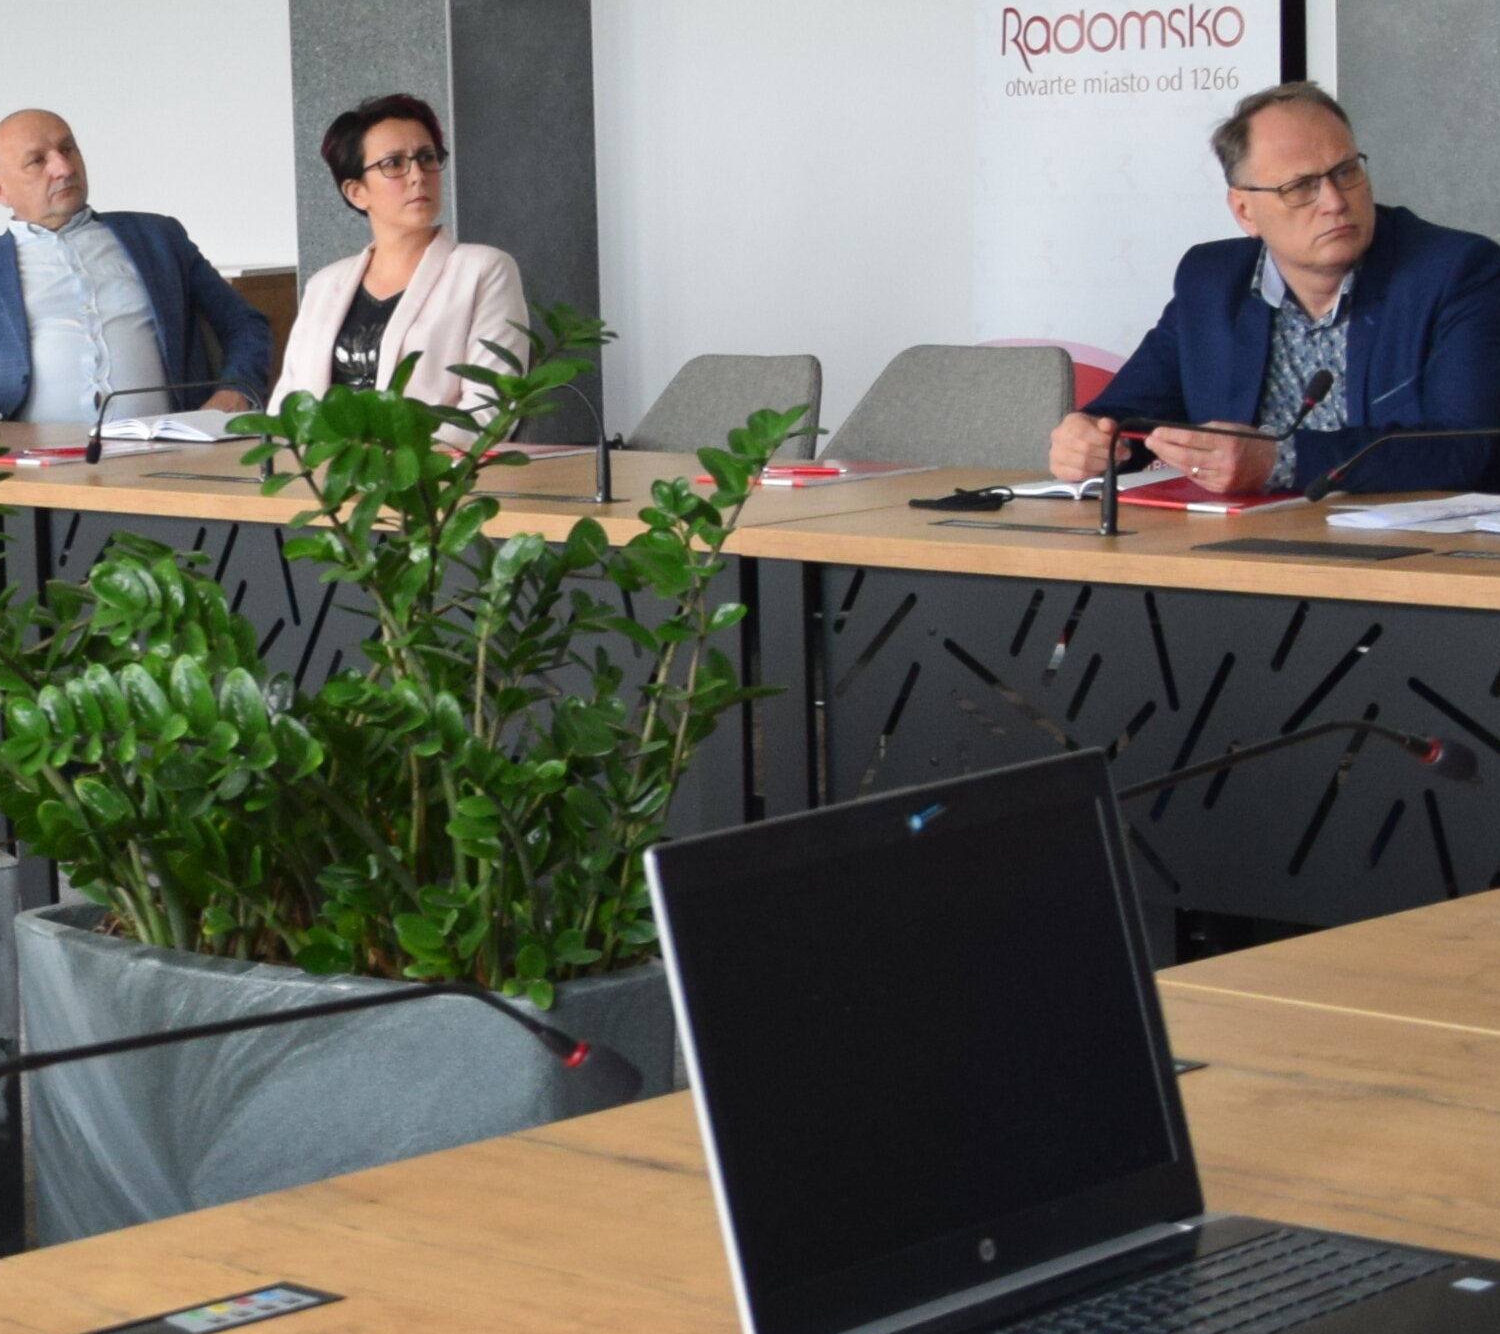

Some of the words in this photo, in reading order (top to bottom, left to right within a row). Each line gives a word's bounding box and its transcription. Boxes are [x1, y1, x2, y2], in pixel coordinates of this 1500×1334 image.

[1000, 2, 1246, 74] Radomsko
[1004, 74, 1077, 98] otwarte
[1082, 70, 1150, 95] miasto
[1156, 66, 1184, 92] od
[1190, 66, 1240, 91] 1266
